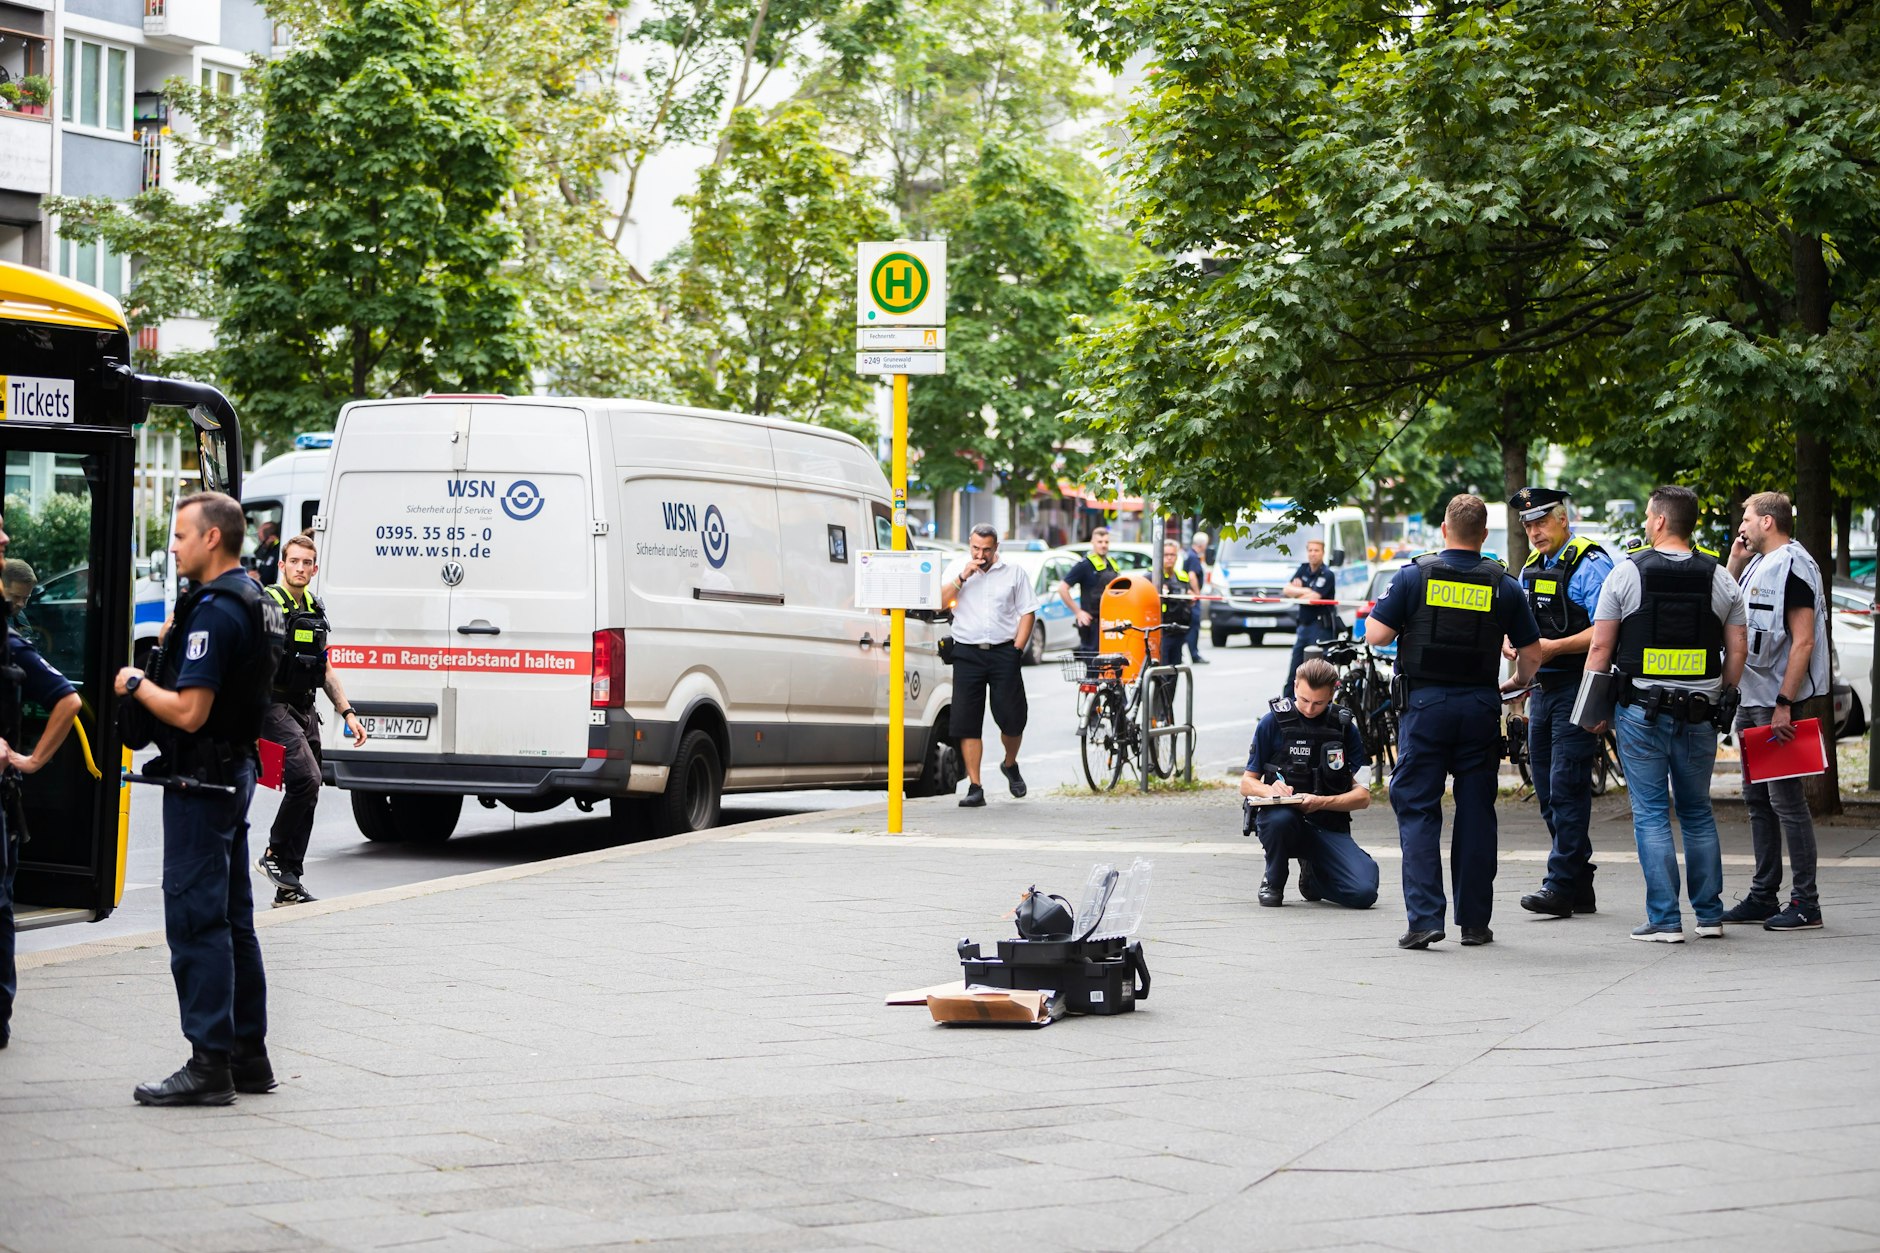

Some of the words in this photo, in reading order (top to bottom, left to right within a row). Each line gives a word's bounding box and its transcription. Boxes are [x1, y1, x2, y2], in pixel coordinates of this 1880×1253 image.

[885, 266, 913, 300] H
[868, 356, 881, 364] 249
[12, 382, 70, 418] Tickets
[447, 479, 496, 498] WSN
[406, 504, 445, 514] Sicherheit
[446, 506, 462, 514] und
[464, 506, 493, 515] Service
[662, 501, 698, 532] WSN
[376, 525, 417, 540] 0395.
[422, 526, 441, 540] 35
[446, 527, 465, 540] 85
[482, 527, 492, 541] 0
[375, 542, 491, 559] www.wsn.de
[636, 542, 666, 556] Sicherheit
[666, 544, 678, 557] und
[679, 545, 699, 559] Service
[1430, 583, 1489, 608] POLIZEI
[1536, 582, 1555, 592] POLIZEI
[331, 647, 365, 664] Bitte
[368, 650, 378, 664] 2
[382, 653, 396, 664] m
[401, 650, 520, 669] Rangierabstand
[525, 652, 576, 669] halten
[1646, 652, 1704, 671] POLIZEI
[385, 718, 403, 733] WN
[406, 719, 423, 734] 70
[1289, 746, 1311, 756] POLIZEI
